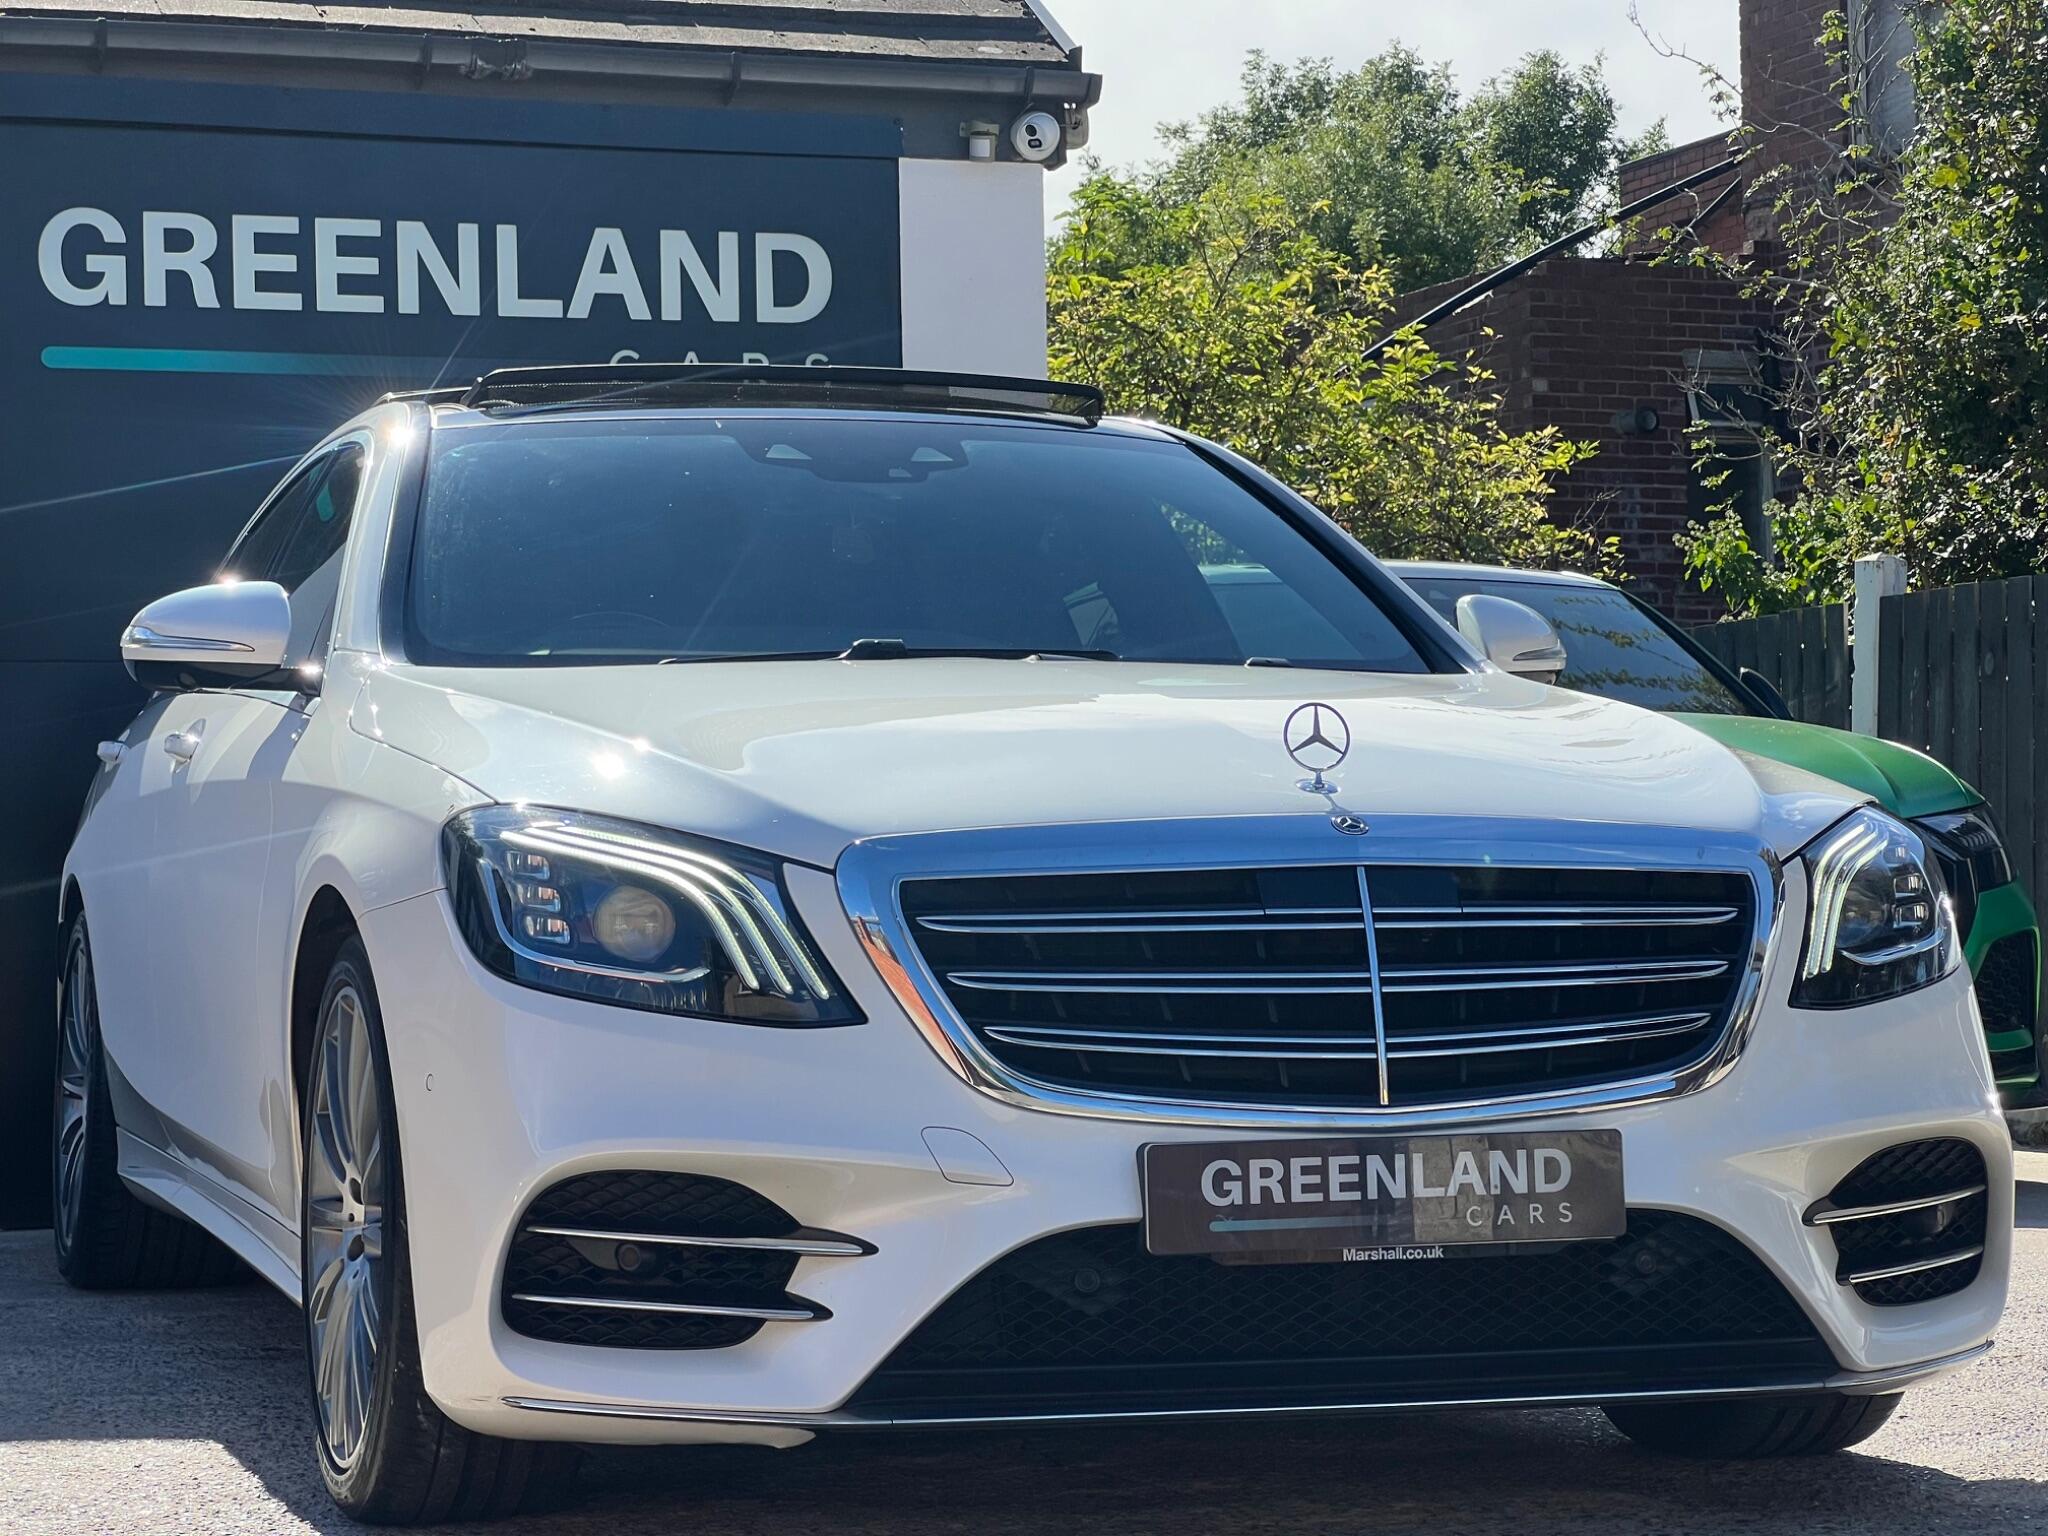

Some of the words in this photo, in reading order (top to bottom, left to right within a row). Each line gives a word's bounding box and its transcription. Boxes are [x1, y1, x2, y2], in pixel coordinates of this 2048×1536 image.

[38, 207, 833, 323] GREENLAND
[1200, 1148, 1572, 1206] GREENLAND
[1466, 1202, 1573, 1227] CARS
[1342, 1245, 1444, 1262] Marshall.co.uk
